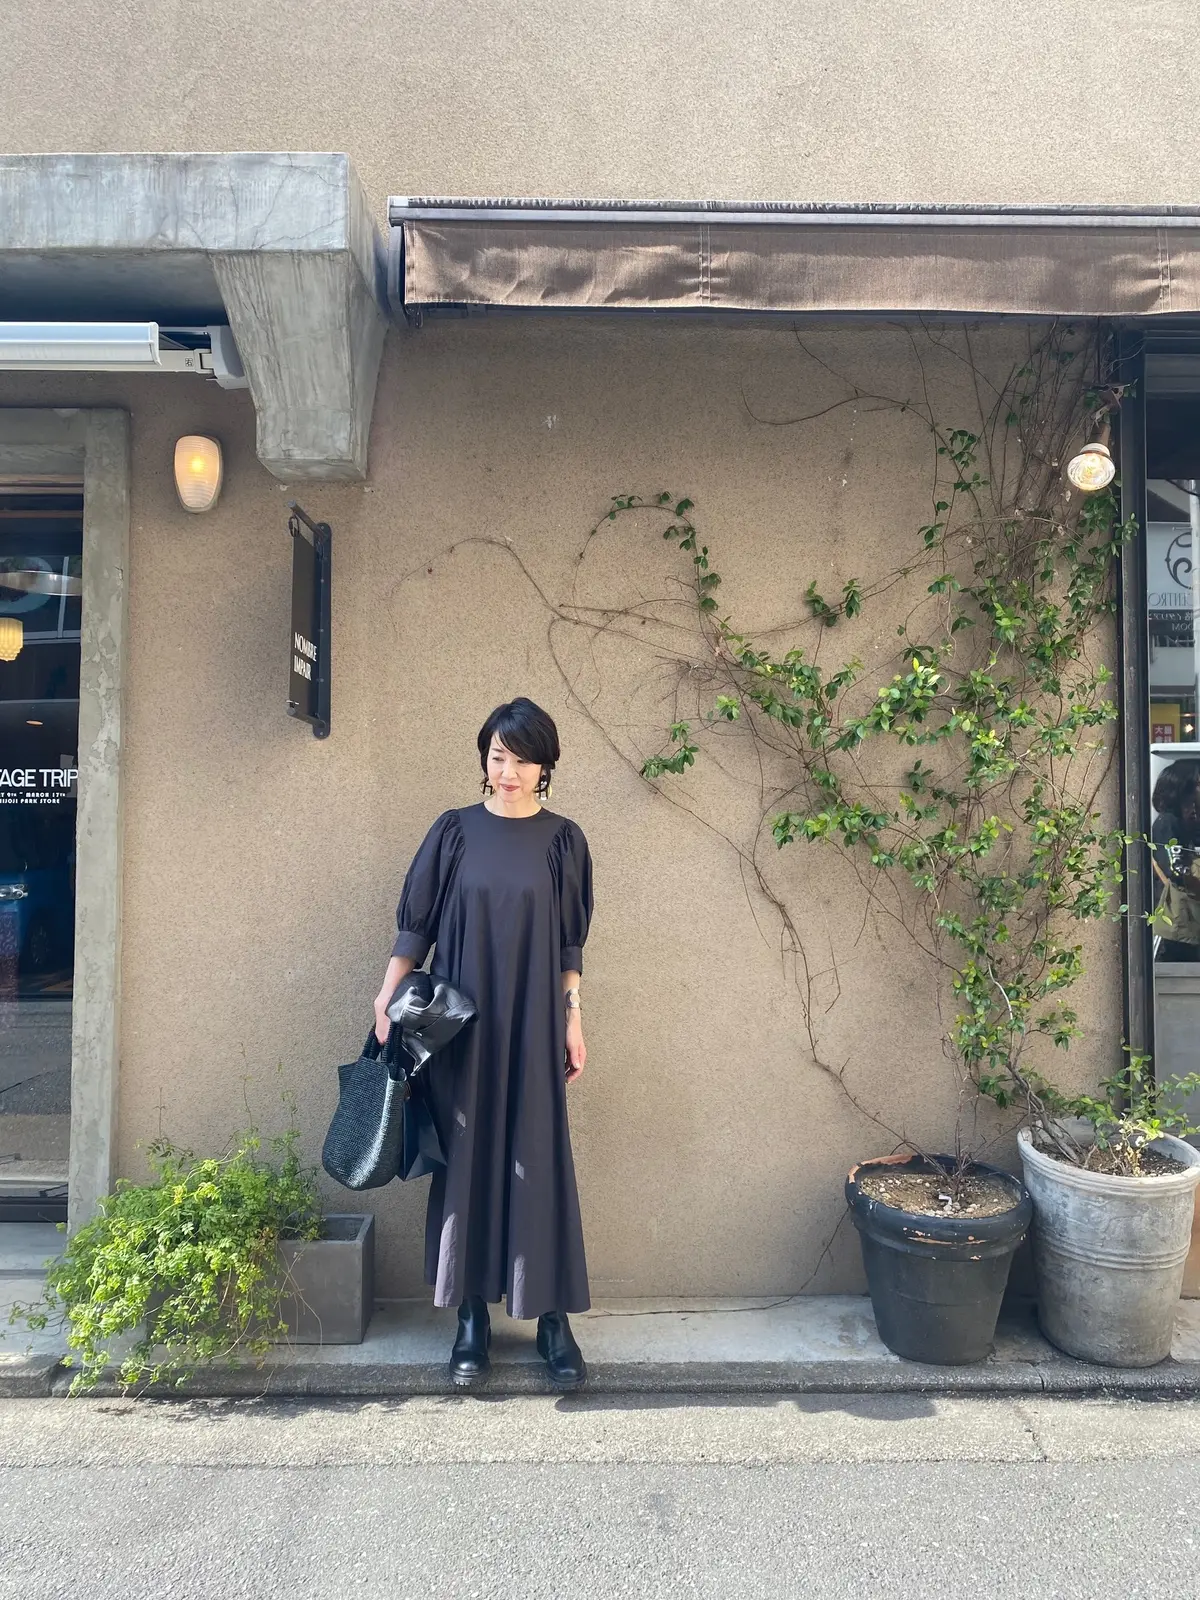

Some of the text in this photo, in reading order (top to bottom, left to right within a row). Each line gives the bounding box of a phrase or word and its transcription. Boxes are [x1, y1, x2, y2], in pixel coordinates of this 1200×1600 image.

[294, 631, 317, 661] NOMBRE
[0, 769, 78, 787] AGE TRIP
